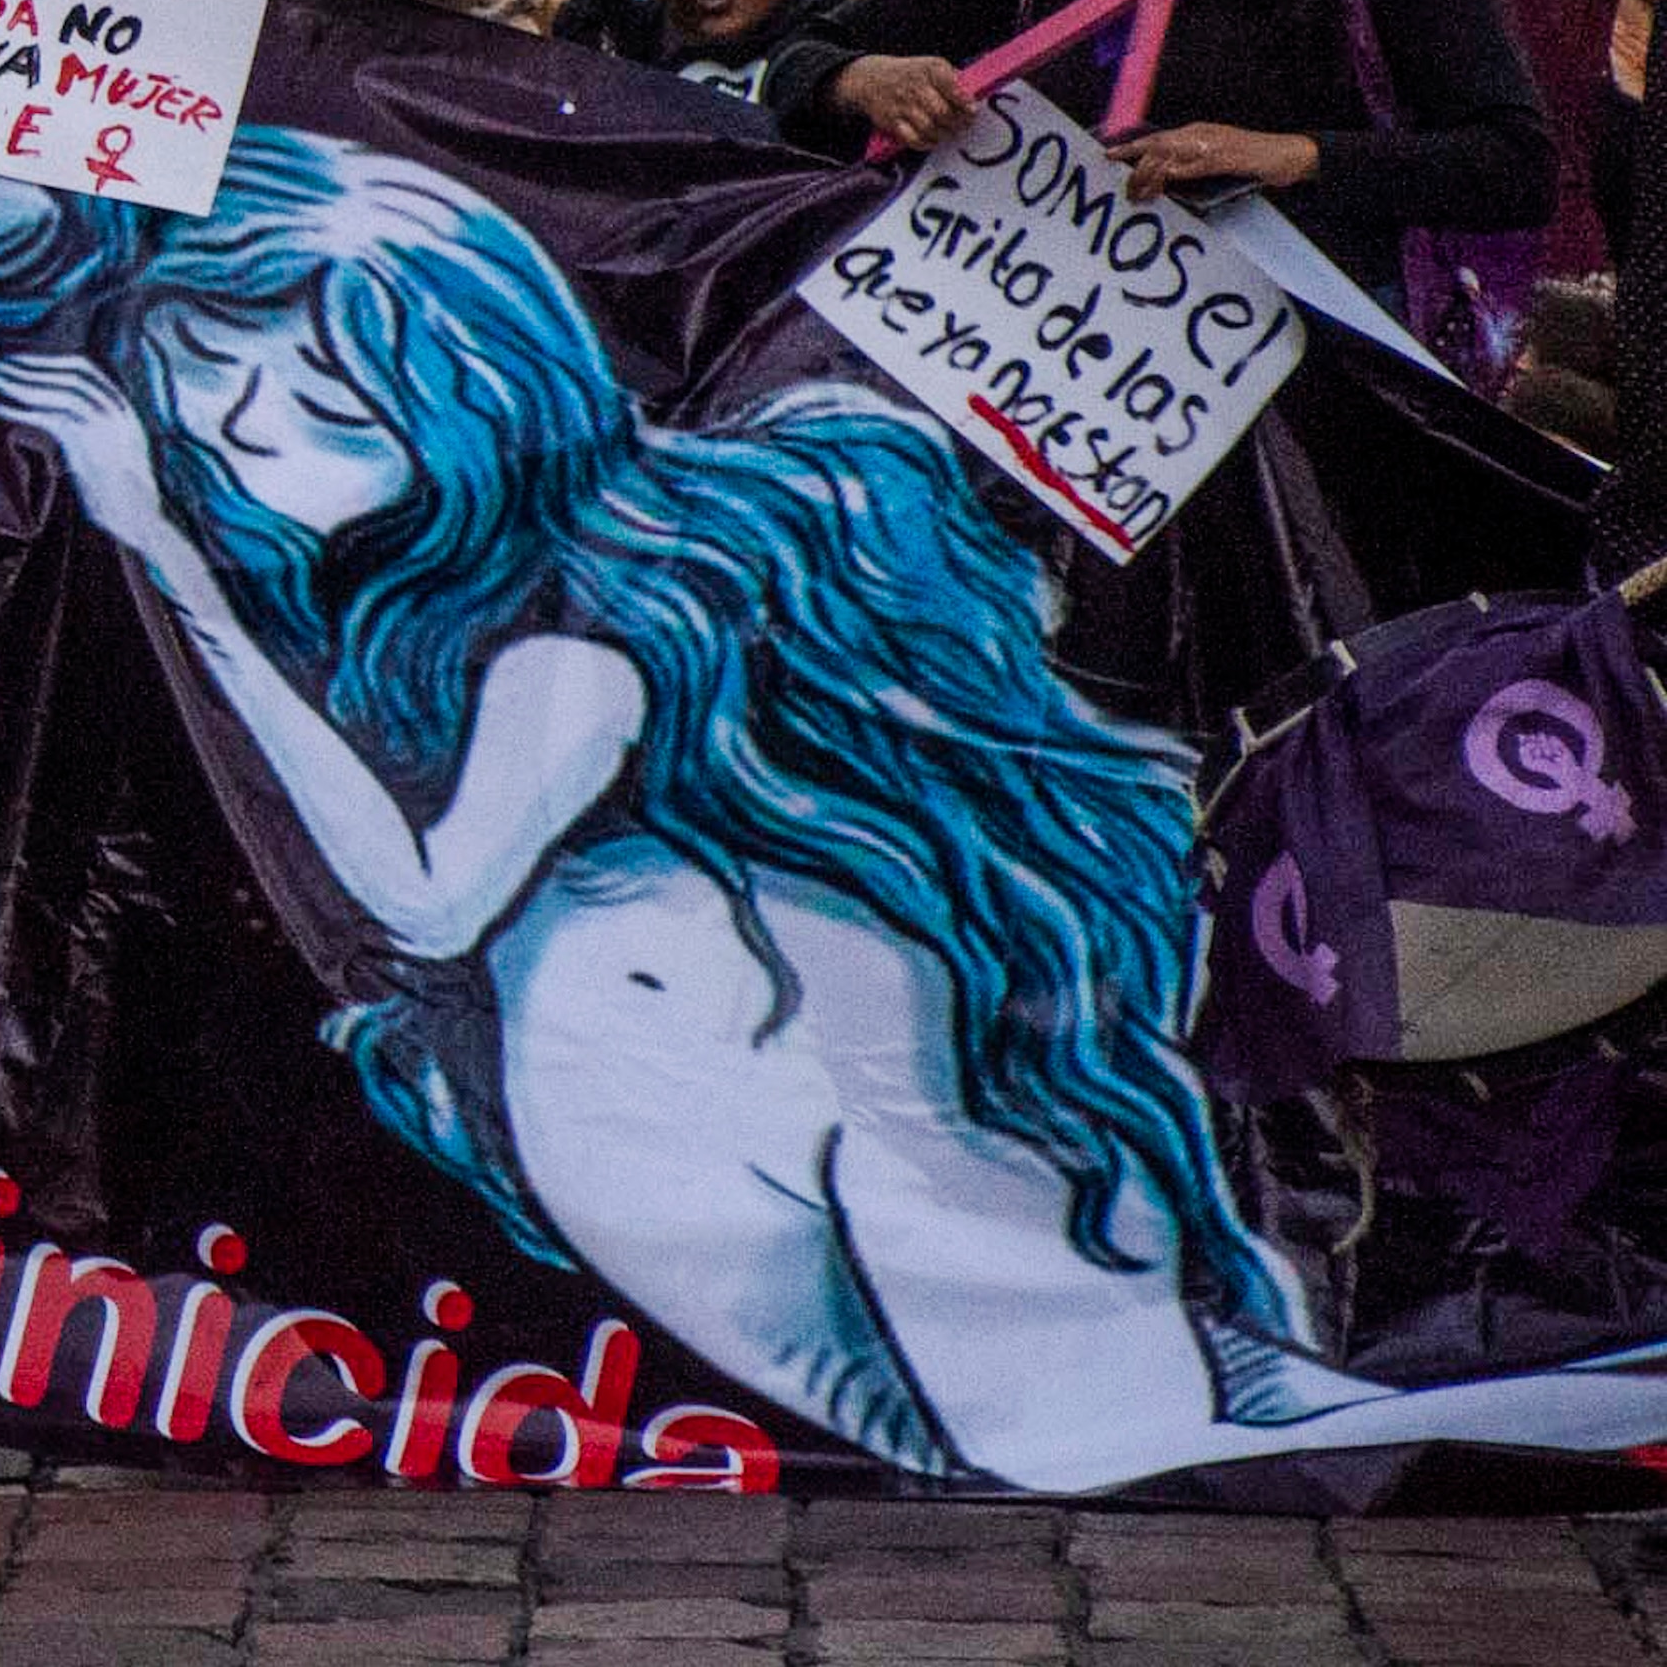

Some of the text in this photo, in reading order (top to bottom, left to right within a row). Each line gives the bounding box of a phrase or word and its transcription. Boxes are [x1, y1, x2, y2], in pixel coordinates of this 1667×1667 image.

[55, 52, 225, 134] MUJER
[58, 2, 144, 56] NO
[908, 174, 1209, 457] Grito de las
[958, 91, 1290, 388] SOMOS el
